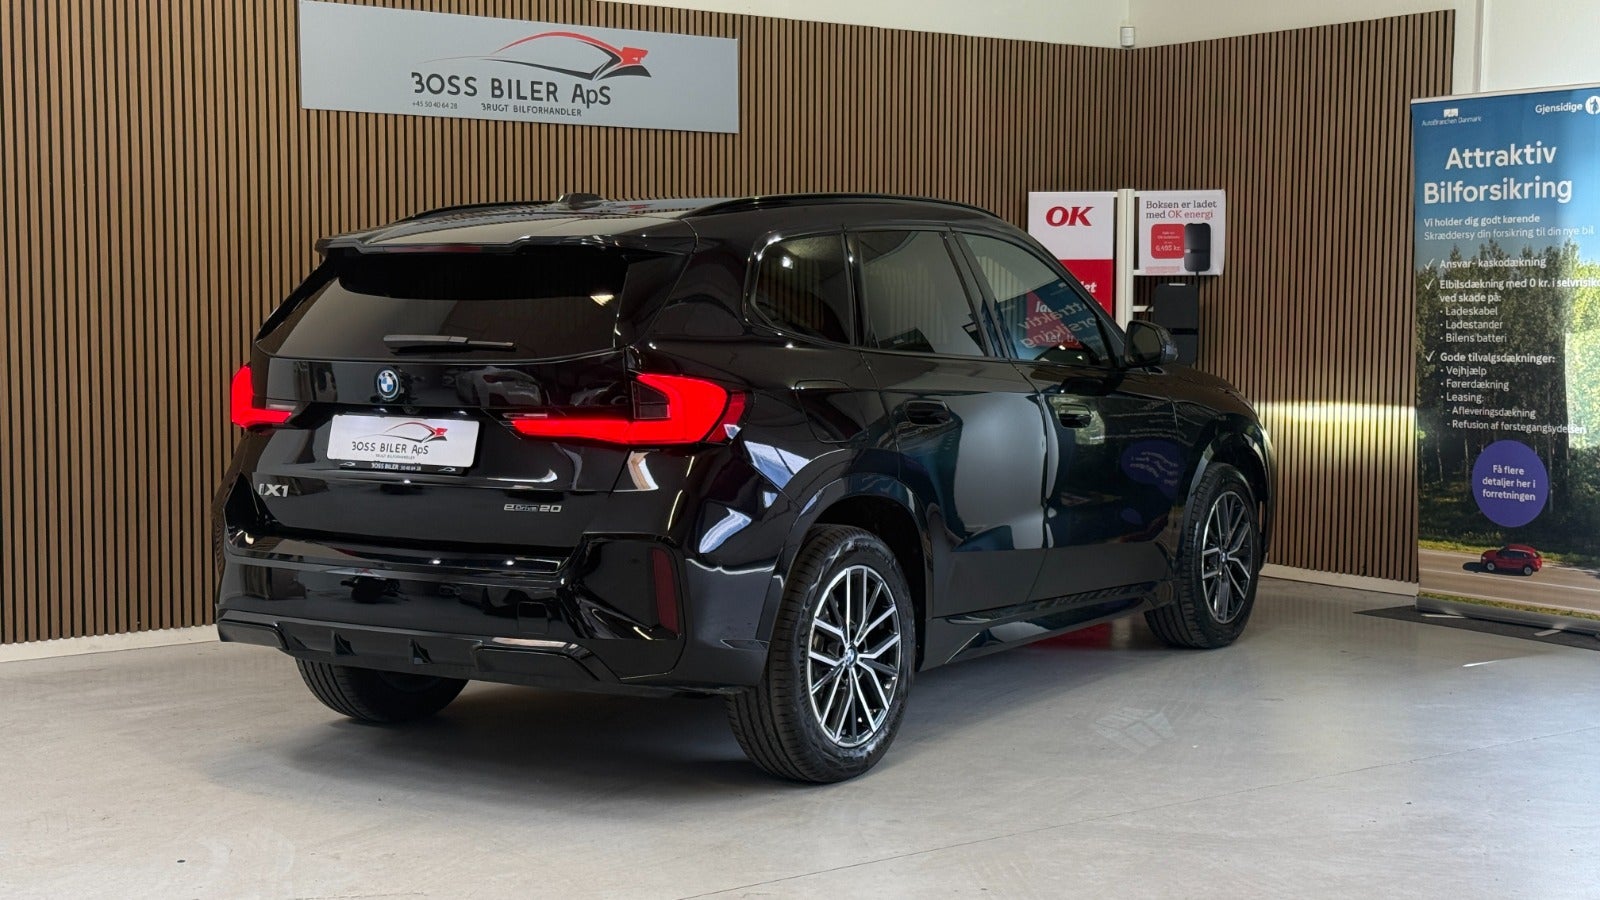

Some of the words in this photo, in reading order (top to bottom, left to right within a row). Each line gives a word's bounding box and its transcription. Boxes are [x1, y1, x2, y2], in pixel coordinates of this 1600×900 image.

[411, 72, 478, 97] BOSS
[491, 78, 558, 102] BILER
[572, 84, 611, 108] ApS
[481, 103, 509, 112] BRUGT
[513, 105, 582, 117] BILFORHANDLER
[1535, 102, 1583, 115] Gjensidige
[1445, 140, 1557, 170] Attraktiv
[1424, 176, 1572, 204] Bilforsikring
[1146, 201, 1178, 209] Boksen
[1194, 200, 1218, 208] ladet
[1046, 206, 1094, 227] OK
[1146, 210, 1165, 219] med
[1168, 210, 1182, 218] OK
[1184, 210, 1213, 220] energi
[1424, 218, 1433, 228] Vi
[1434, 218, 1462, 227] holder
[1464, 217, 1479, 228] dig
[1481, 216, 1501, 227] godt
[1502, 214, 1540, 224] kørende
[1424, 231, 1474, 242] Skræddersy
[1477, 230, 1491, 239] din
[1492, 229, 1534, 239] forsikring
[1536, 228, 1546, 236] til
[1548, 227, 1562, 236] din
[1564, 228, 1581, 237] nye
[1582, 226, 1594, 235] bil
[1478, 258, 1546, 269] kaskodækning
[1440, 279, 1504, 291] Elbilsdækning
[1506, 279, 1526, 289] med
[1529, 279, 1535, 287] 0
[1538, 279, 1550, 287] kr.
[1440, 293, 1456, 302] ved
[1458, 293, 1486, 302] skade
[1488, 293, 1502, 304] på:
[1445, 307, 1498, 316] Ladeskabel
[1445, 320, 1503, 329] Ladestander
[1446, 333, 1474, 342] Bilens
[1477, 333, 1507, 342] batteri
[1440, 352, 1466, 362] Gode
[1468, 352, 1556, 364] tilvalgsdækninger:
[1446, 366, 1487, 377] Vejhjælp
[1446, 379, 1509, 391] Førerdækning
[1452, 406, 1536, 420] Afleveringsdækning
[1452, 420, 1489, 430] Refusion
[1491, 420, 1499, 430] af
[352, 441, 376, 452] BOSS
[380, 443, 407, 454] BILER
[412, 445, 429, 456] ApS
[1493, 465, 1503, 474] Få
[1504, 466, 1525, 475] flere
[1482, 476, 1514, 488] detaljer
[1516, 478, 1531, 487] her
[1482, 489, 1536, 502] forretningen
